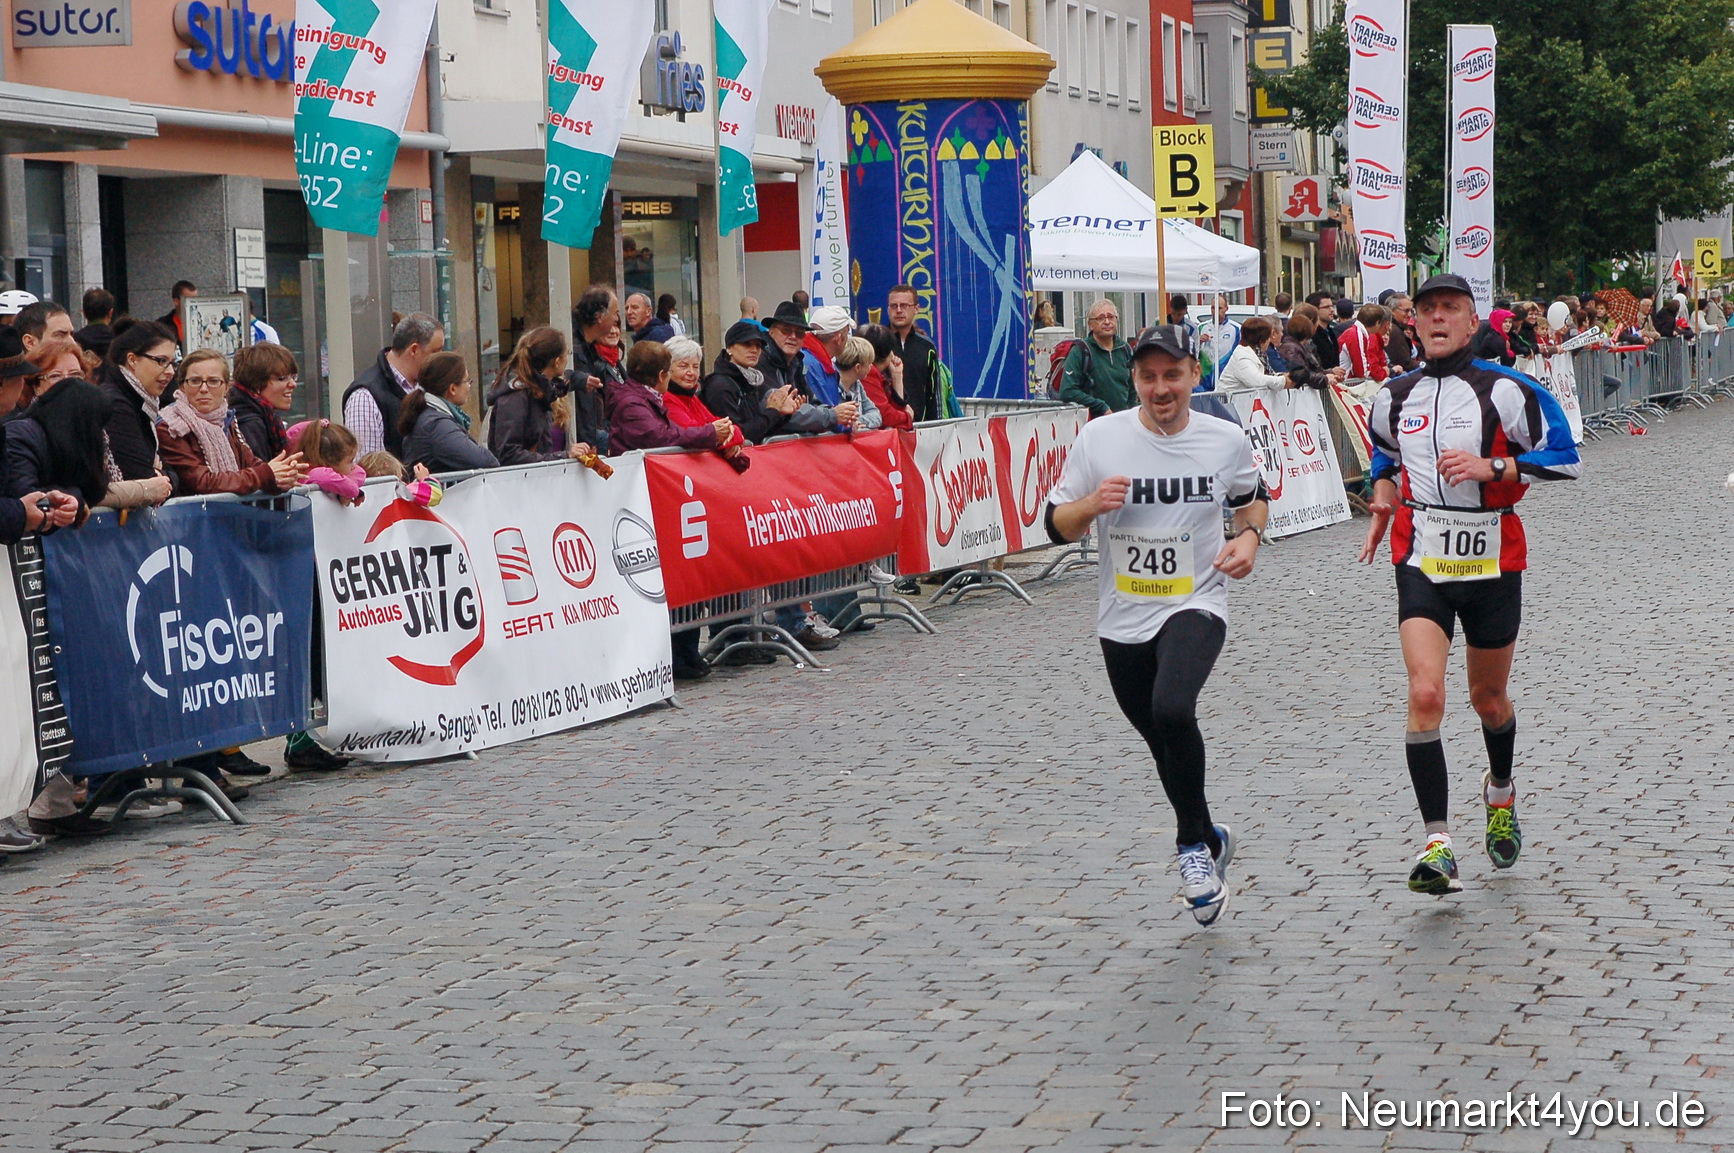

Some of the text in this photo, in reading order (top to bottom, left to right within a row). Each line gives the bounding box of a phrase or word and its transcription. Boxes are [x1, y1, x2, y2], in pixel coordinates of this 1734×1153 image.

[15, 3, 120, 36] sutor.
[295, 23, 387, 65] einigung
[548, 60, 604, 91] igung
[656, 30, 705, 113] fries
[294, 80, 377, 107] erdienst
[777, 103, 816, 144] Weltbild
[1160, 128, 1207, 147] Block
[1258, 141, 1287, 150] Stern
[1169, 153, 1201, 199] B
[622, 202, 673, 215] FRIES
[1701, 249, 1714, 268] C
[1403, 417, 1421, 427] tkn
[742, 493, 878, 548] Herzlich willkommen
[1427, 515, 1489, 528] PARTL Neumarkt
[1110, 533, 1178, 544] PARTL Neumarkt
[1439, 529, 1487, 556] 106
[458, 552, 467, 575] &
[557, 538, 592, 574] KIA
[1127, 545, 1177, 575] 248
[1436, 561, 1483, 576] Wolfgang
[1131, 580, 1173, 594] Günther
[338, 603, 403, 632] Autohaus
[561, 594, 620, 626] KIA MOTORS
[502, 611, 555, 640] SEAT
[335, 719, 427, 752] Neumarkt
[481, 702, 506, 731] Tel.
[564, 682, 589, 713] 80-0
